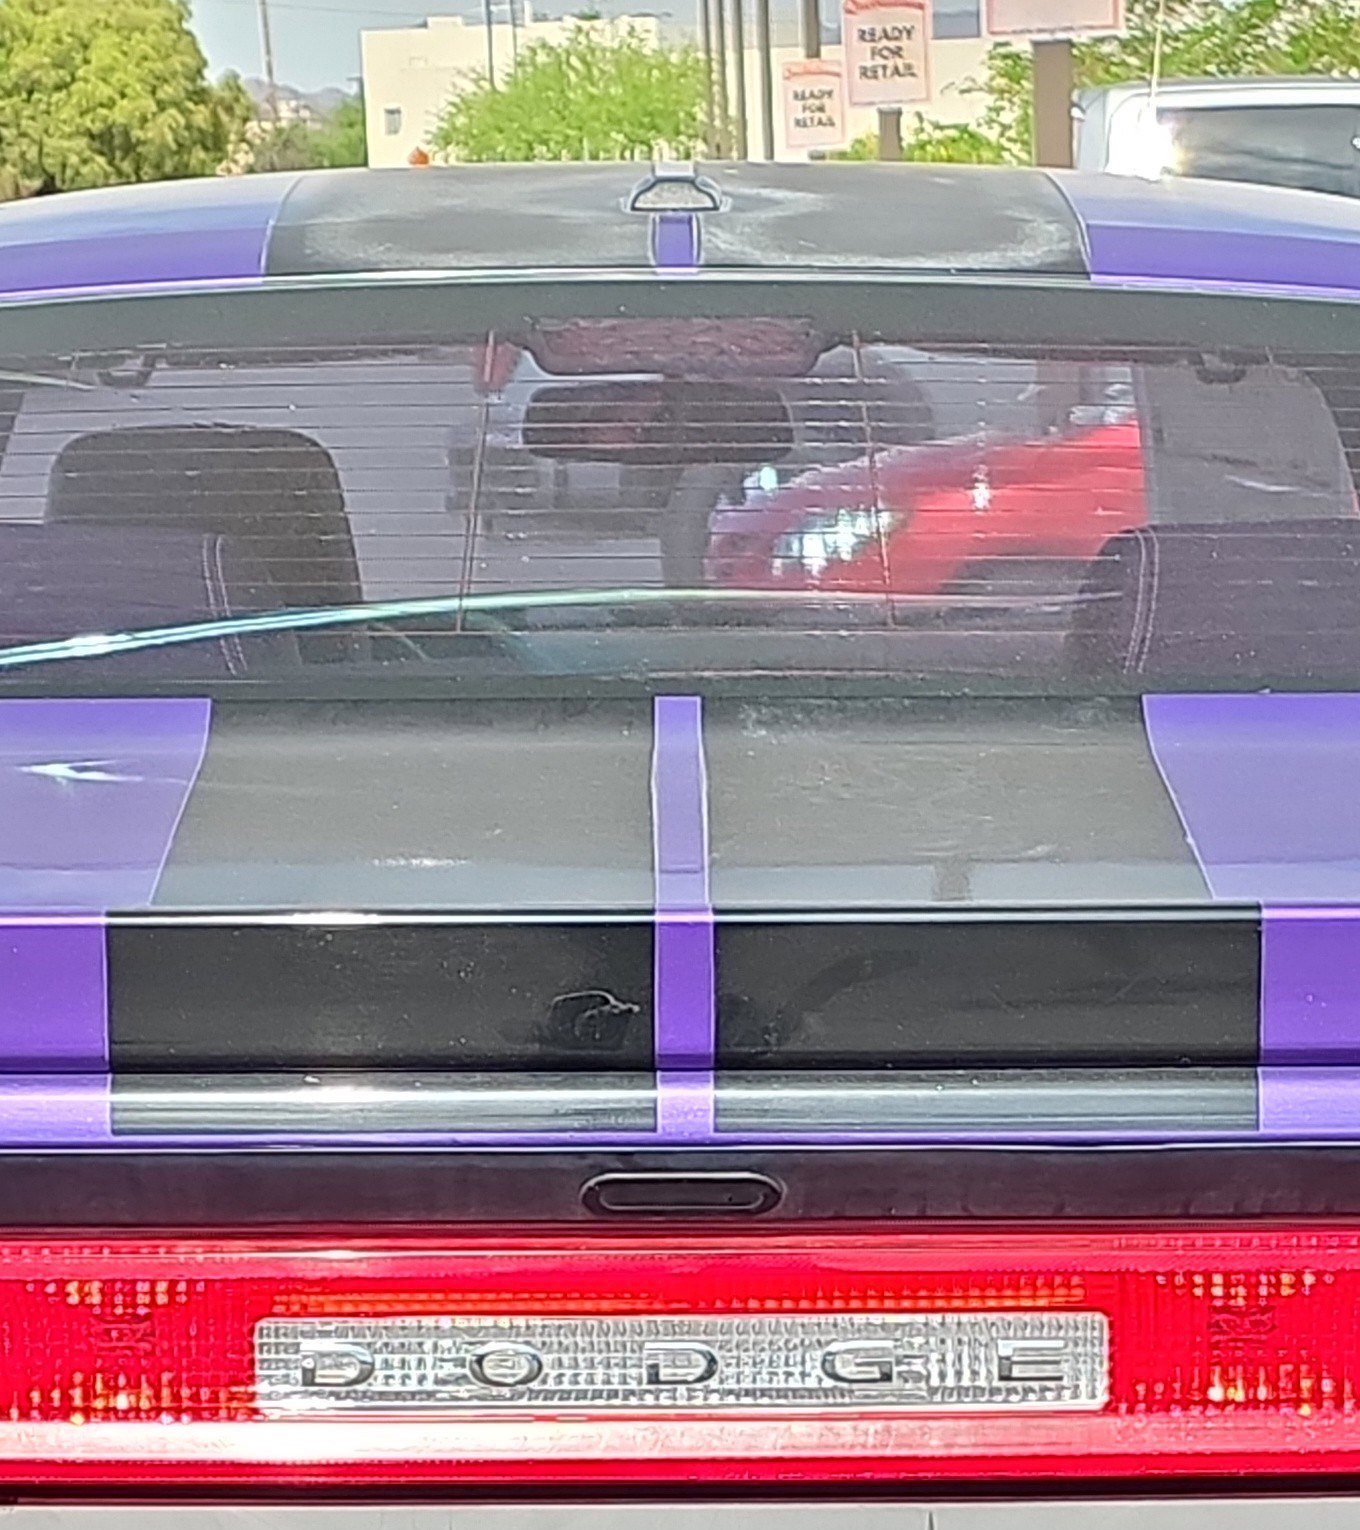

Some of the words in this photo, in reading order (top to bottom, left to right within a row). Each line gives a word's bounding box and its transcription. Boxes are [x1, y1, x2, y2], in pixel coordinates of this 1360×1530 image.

[857, 25, 915, 42] READY
[870, 45, 904, 60] FOR
[299, 1338, 1066, 1388] DODGE
